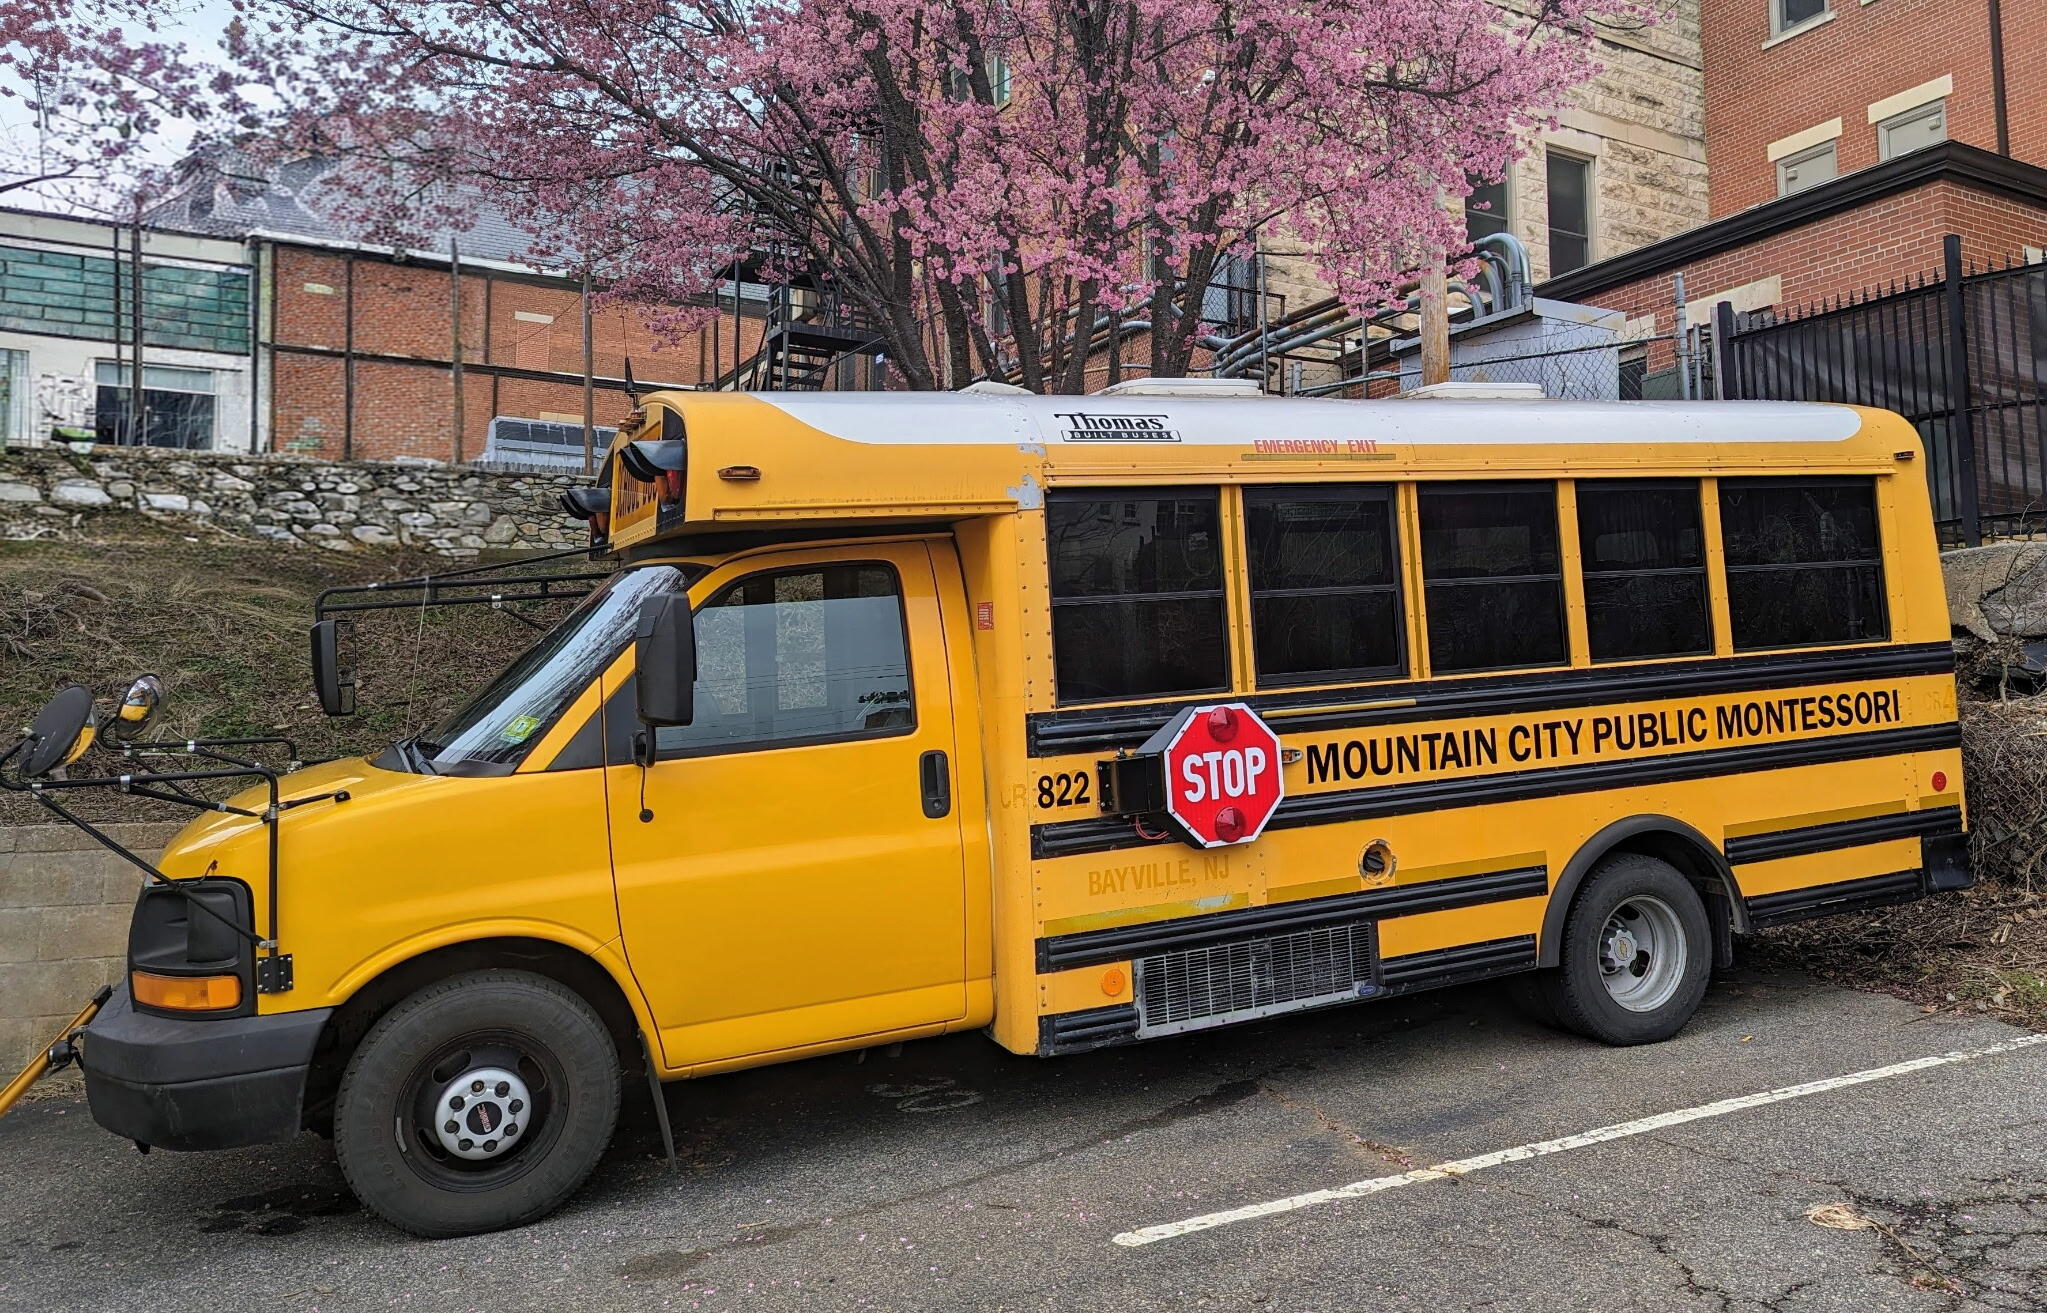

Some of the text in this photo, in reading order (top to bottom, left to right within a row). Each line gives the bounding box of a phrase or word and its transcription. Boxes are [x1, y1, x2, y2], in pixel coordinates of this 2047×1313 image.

[1054, 412, 1168, 430] Thomas
[1073, 431, 1169, 439] BUILT BUSES
[1254, 439, 1378, 453] EMERGENCY EXIT
[1307, 689, 1901, 784] MOUNTAIN CITY PUBLIC MONTESSORI
[1037, 771, 1090, 809] 822
[1182, 747, 1266, 803] STOP
[1089, 854, 1230, 896] BAYVILLE, NJ
